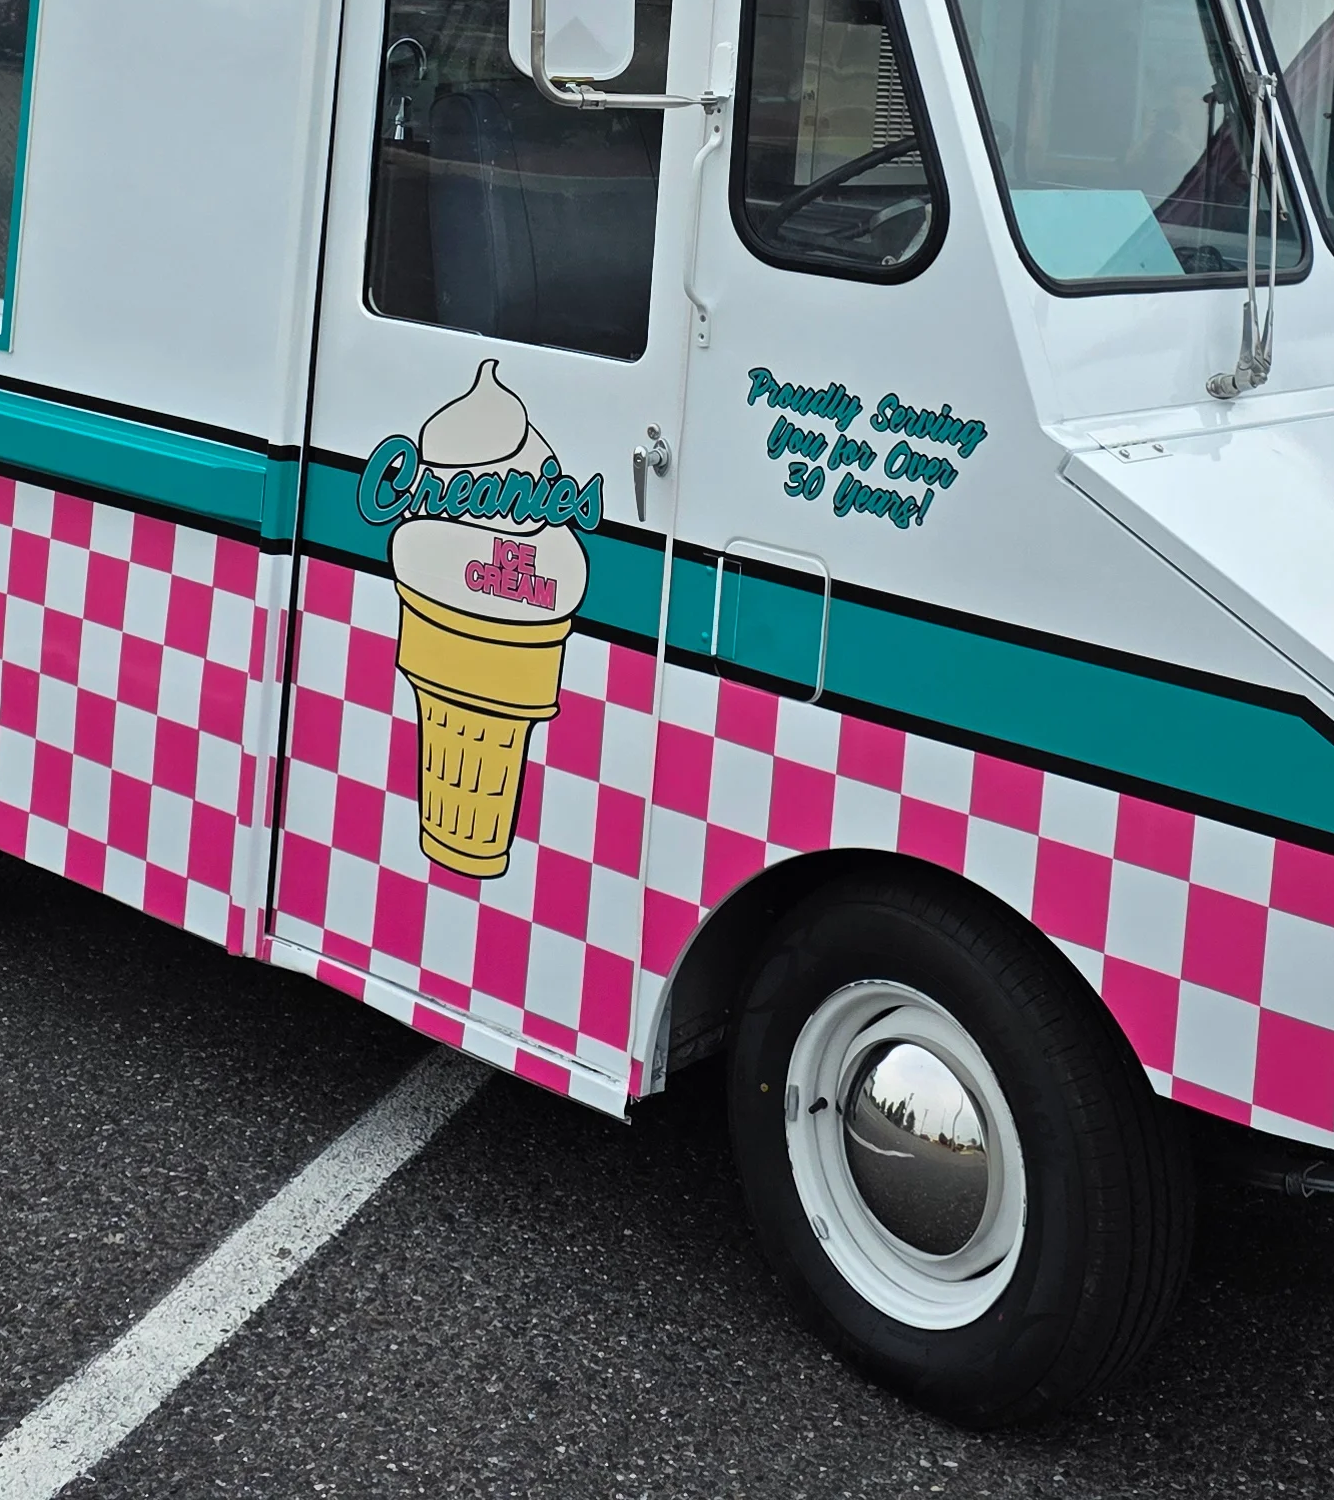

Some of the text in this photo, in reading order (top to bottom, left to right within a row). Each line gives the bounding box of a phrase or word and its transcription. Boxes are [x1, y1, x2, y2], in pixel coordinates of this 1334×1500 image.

[747, 367, 988, 459] Proudly Serving
[356, 434, 604, 534] Creanies
[767, 415, 958, 489] You for Over
[784, 461, 934, 529] 30 Years!
[465, 560, 557, 611] CREAM
[492, 537, 537, 575] ICE
